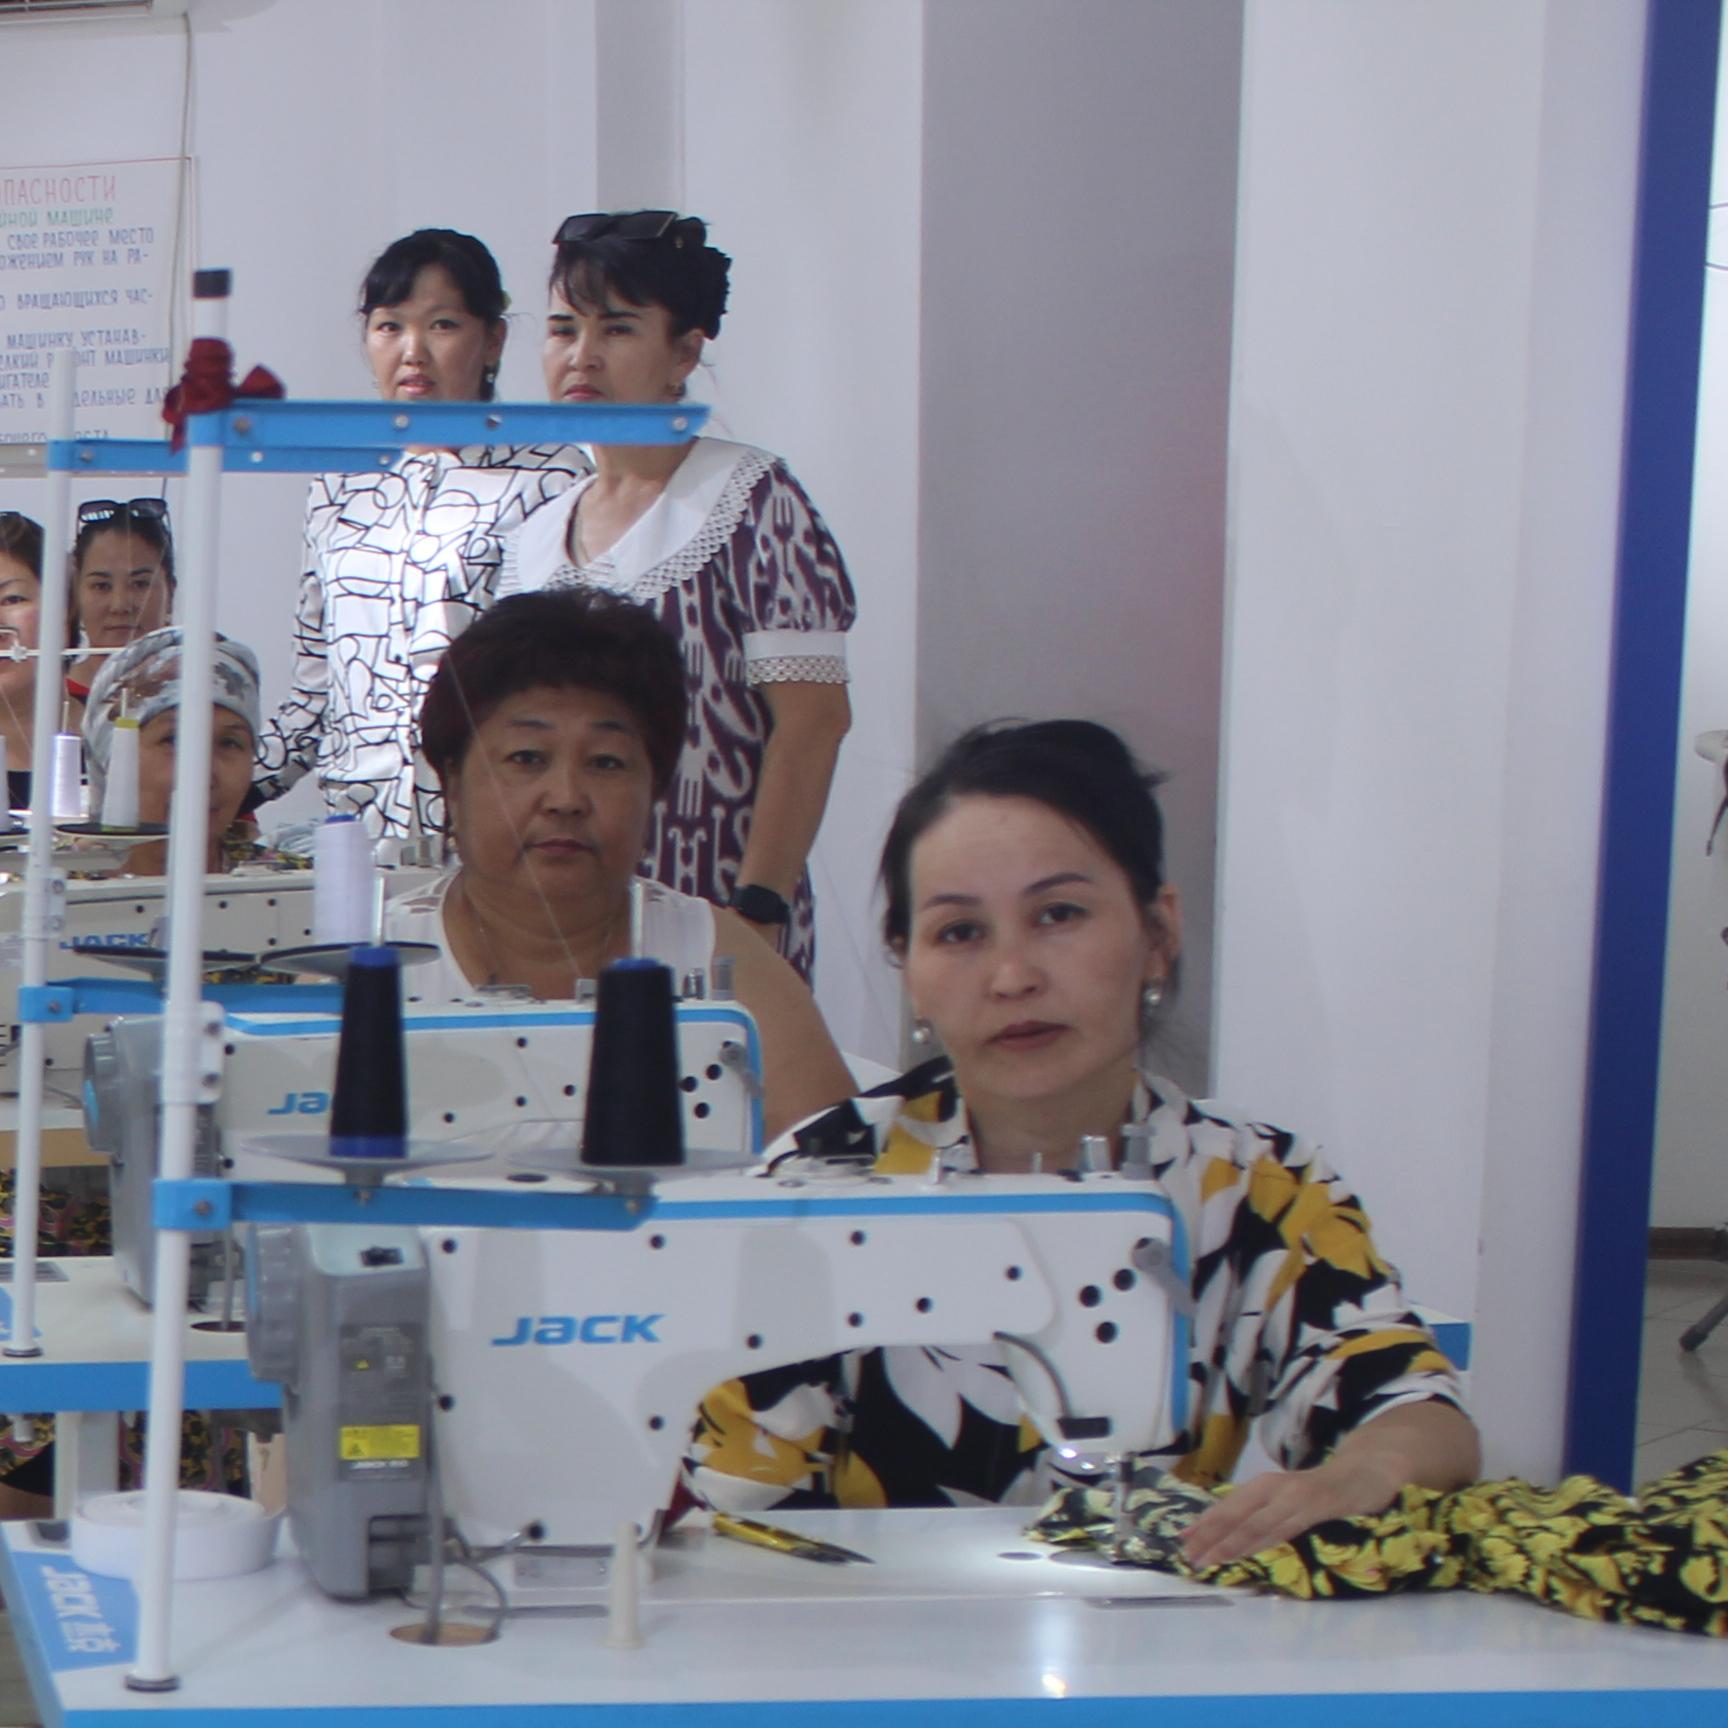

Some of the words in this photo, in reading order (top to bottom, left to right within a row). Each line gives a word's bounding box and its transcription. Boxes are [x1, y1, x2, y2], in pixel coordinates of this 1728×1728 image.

[47, 207, 113, 227] МАШИНЕ
[108, 227, 154, 245] МЕСТО
[102, 249, 117, 265] НА
